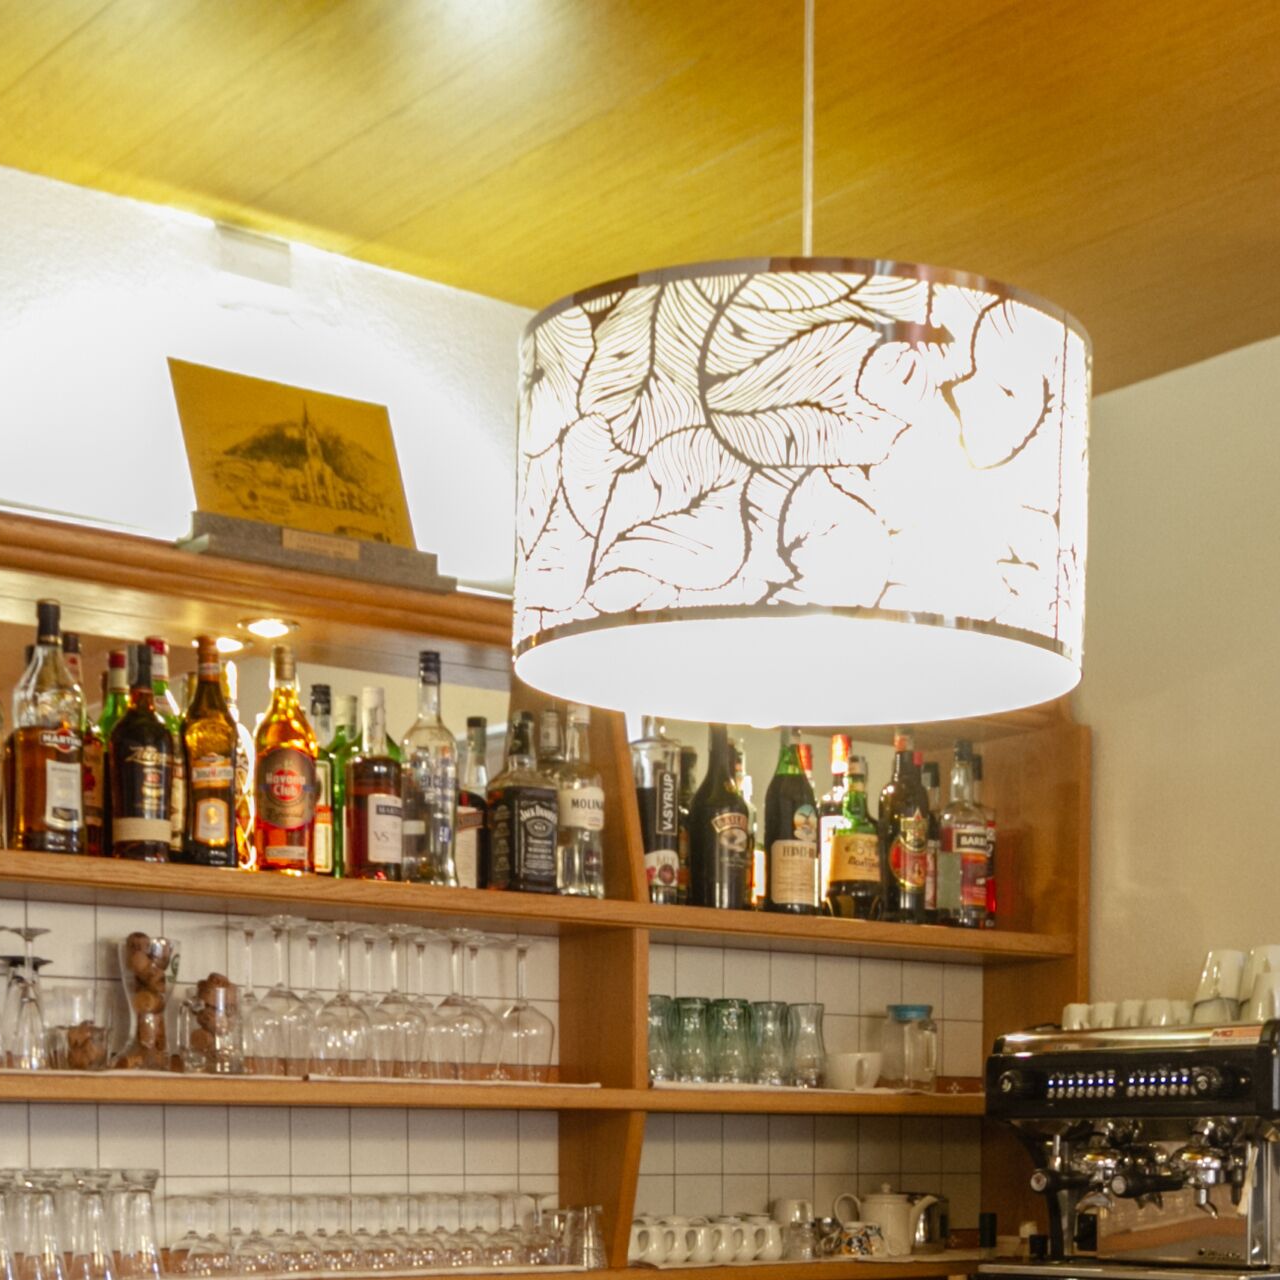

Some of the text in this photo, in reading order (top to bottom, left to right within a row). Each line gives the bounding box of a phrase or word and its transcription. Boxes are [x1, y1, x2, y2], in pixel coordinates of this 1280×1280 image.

[265, 772, 307, 786] Havana
[272, 784, 299, 797] Club
[662, 773, 674, 832] V-SYRUP
